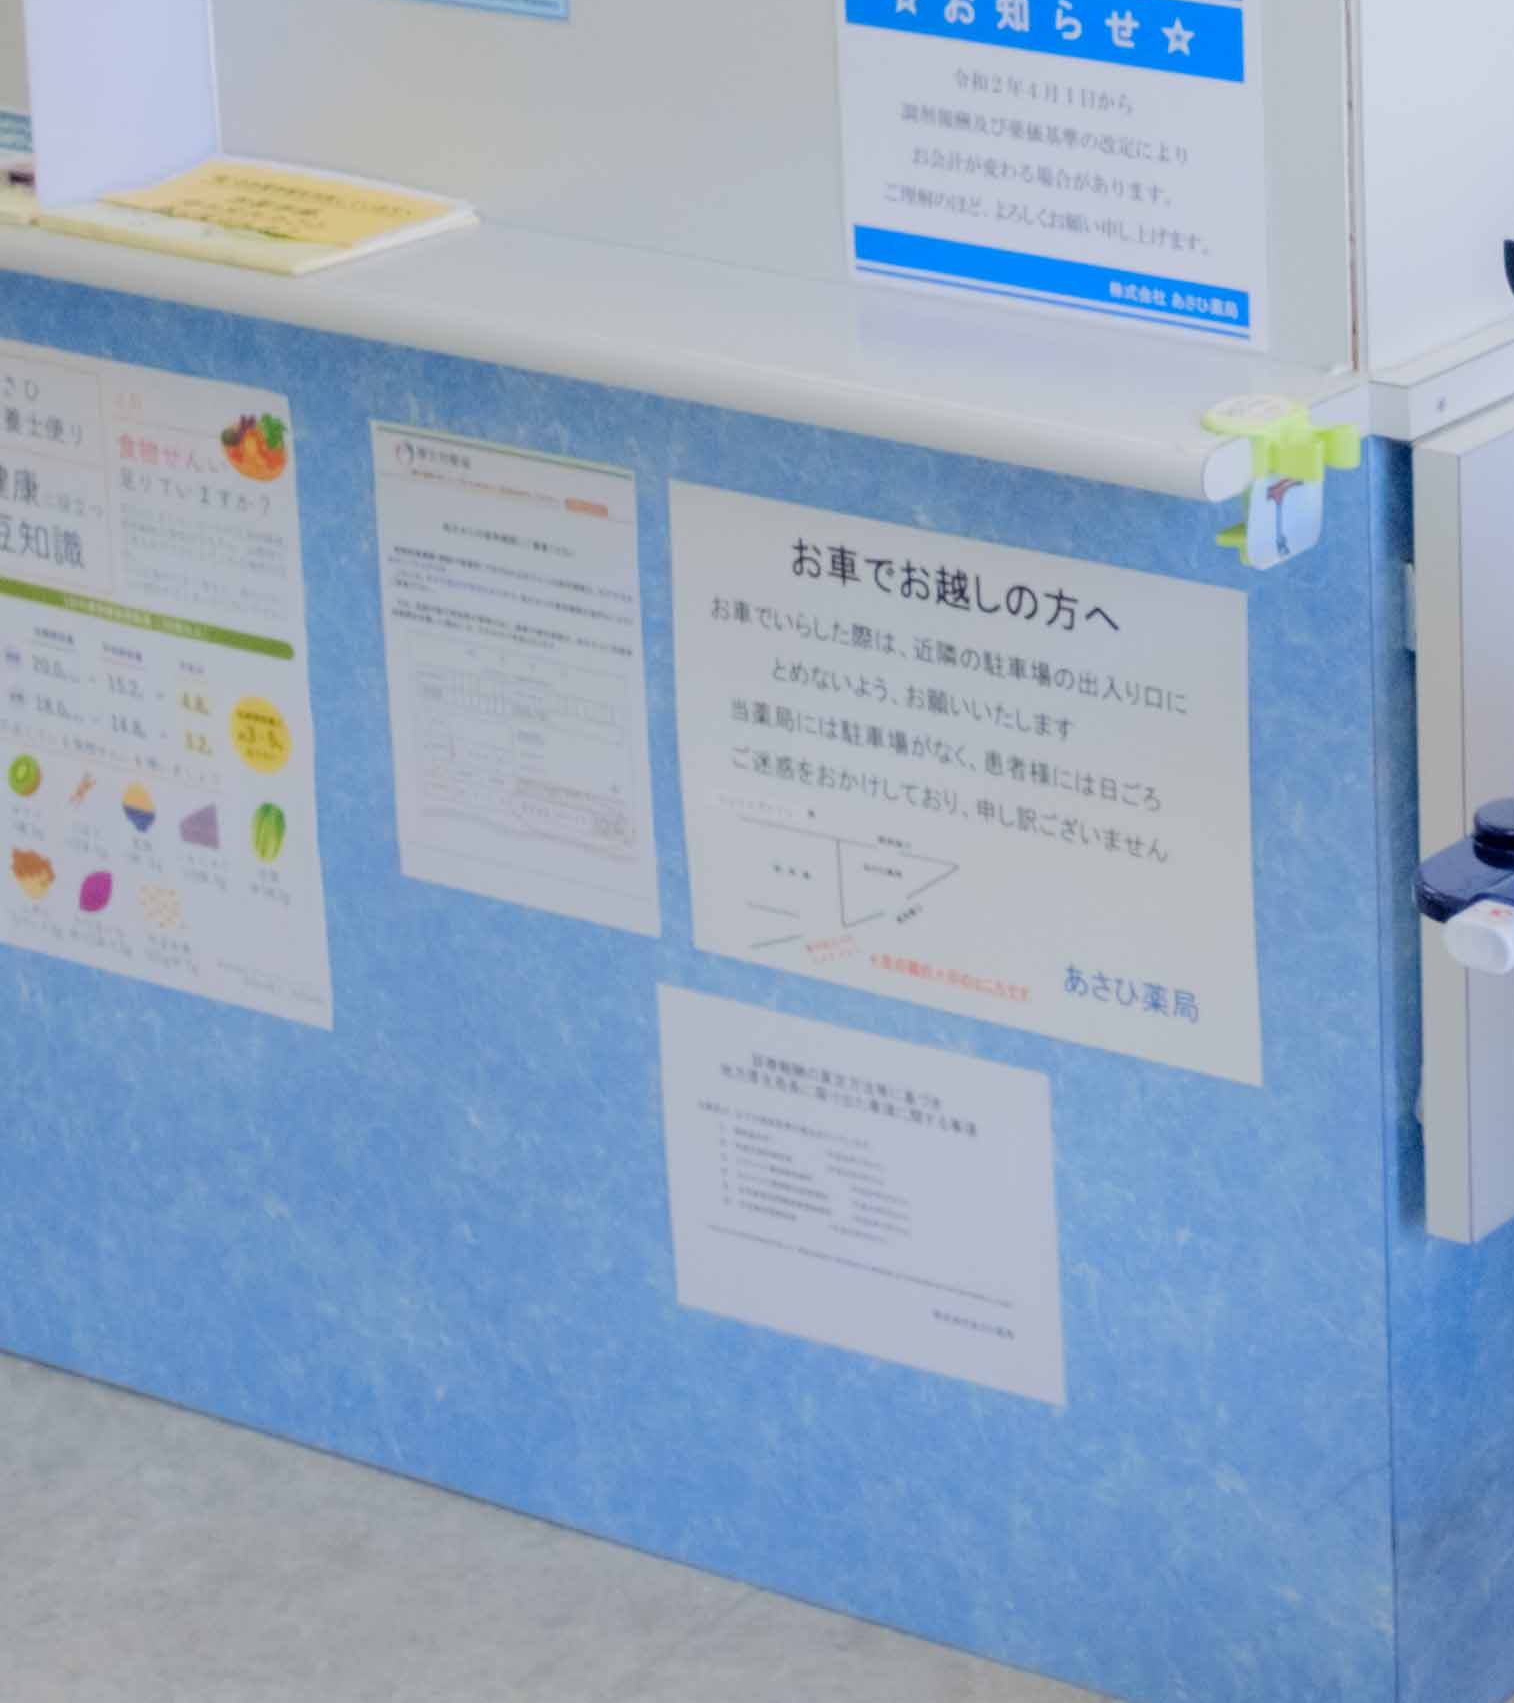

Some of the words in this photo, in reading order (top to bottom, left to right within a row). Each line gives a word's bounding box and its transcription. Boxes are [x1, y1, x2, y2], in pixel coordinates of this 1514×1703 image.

[791, 537, 1120, 634] お車でお越しの方へ
[710, 596, 1189, 716] お車でいらした際は、近隣の駐車場の出入り口に
[770, 656, 1075, 742] とめないよう、お願いいたします
[729, 696, 1162, 813] 当薬局には駐車場がなく、患者様には日ごろ
[730, 746, 1169, 864] ご迷惑をおかけしており、申し訳ございません
[1062, 963, 1200, 1024] あさひ薬局
